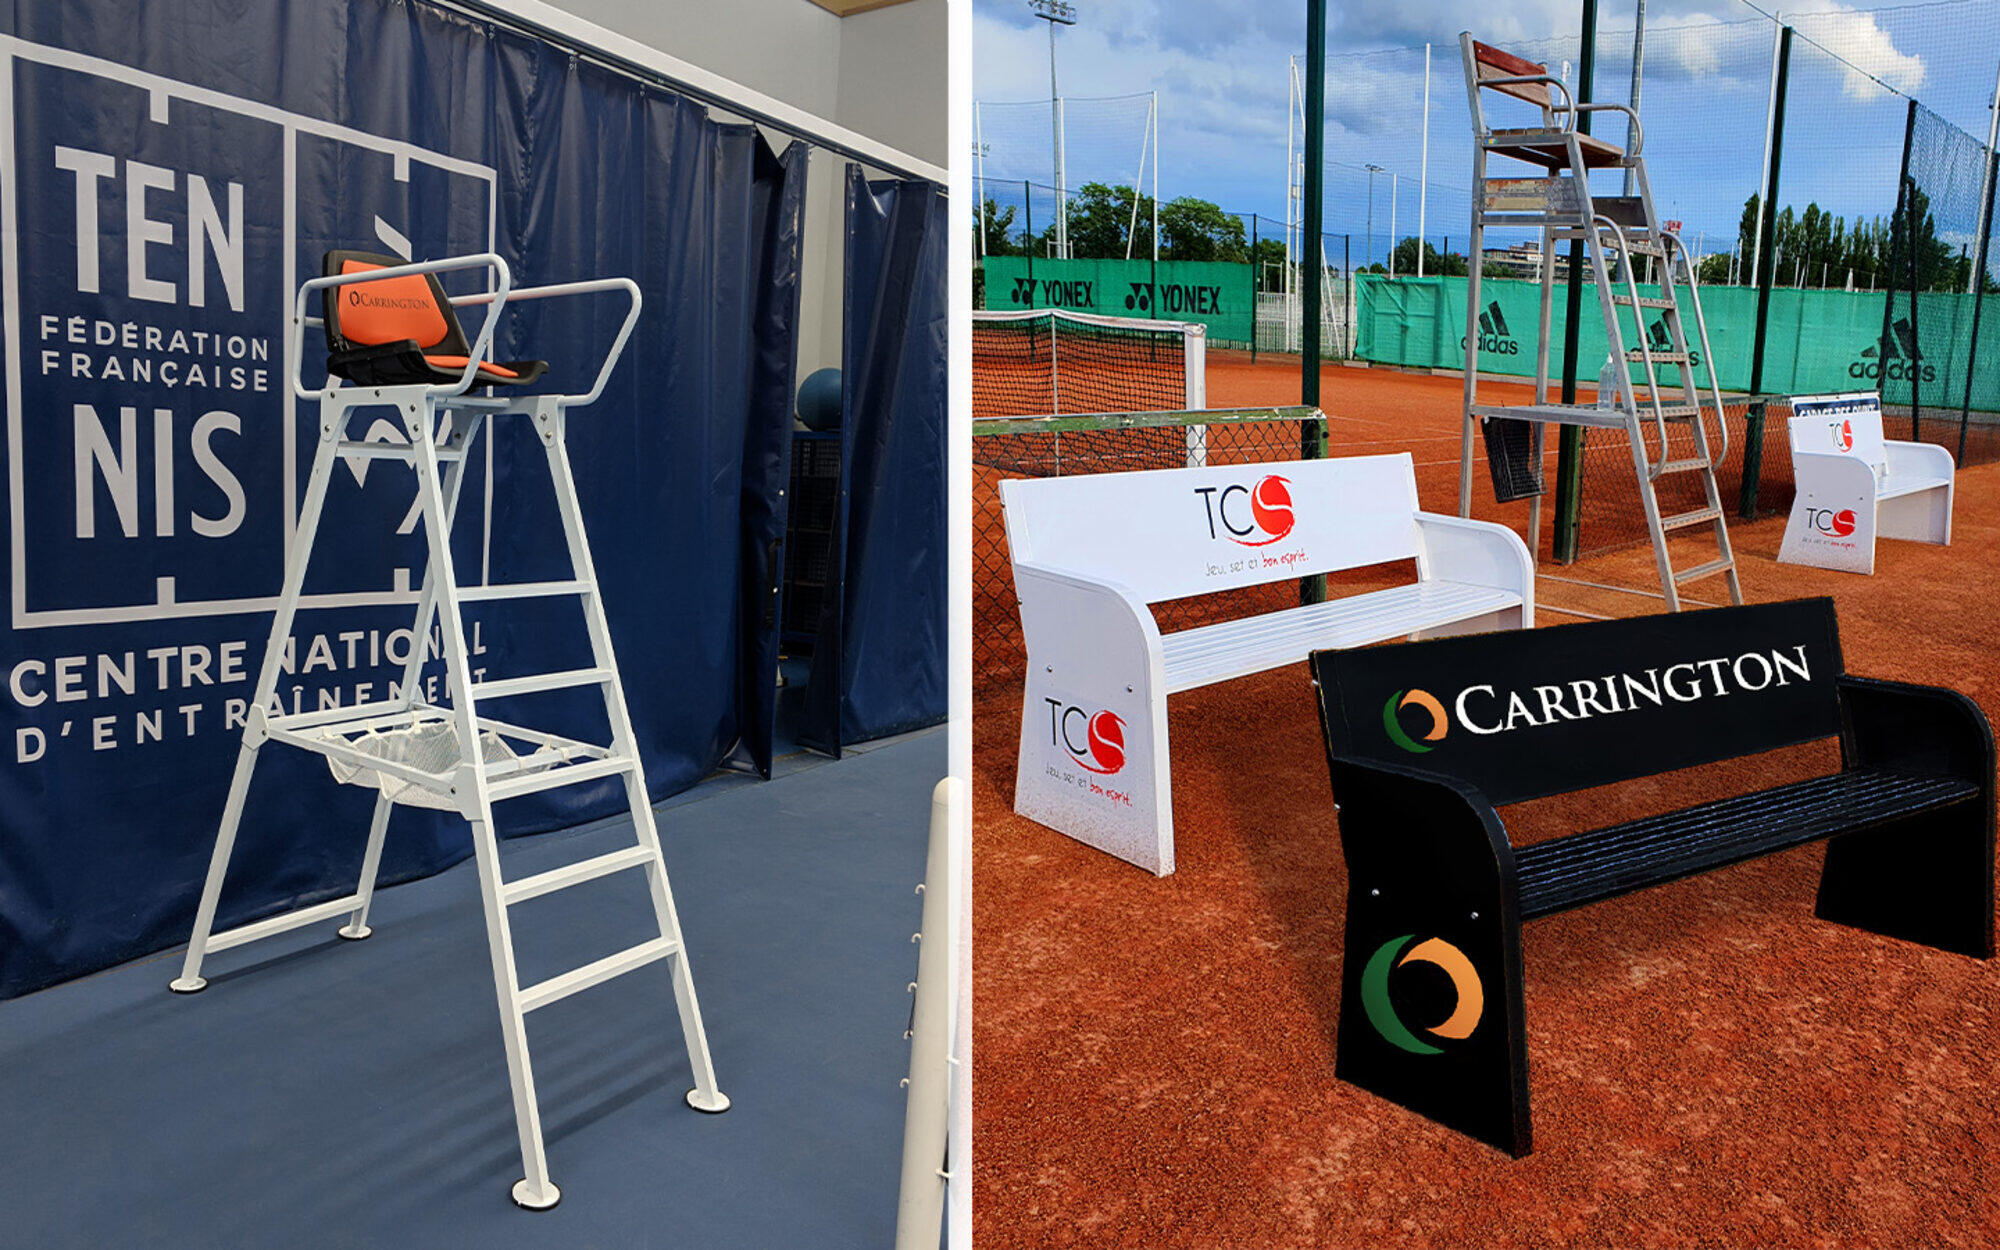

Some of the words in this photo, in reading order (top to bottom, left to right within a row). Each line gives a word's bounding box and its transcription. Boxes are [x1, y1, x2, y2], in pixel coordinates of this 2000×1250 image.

[55, 145, 244, 312] TEN
[1041, 279, 1094, 308] YONEX
[1159, 283, 1222, 315] YONEX
[41, 314, 268, 362] FÉDÉRATION
[41, 350, 268, 392] FRANÇAISE
[1848, 358, 1937, 383] addas
[73, 404, 246, 539] NIS
[1261, 550, 1279, 568] bon
[9, 640, 248, 708] CENTRE
[267, 621, 487, 675] NATIONL
[1454, 645, 1812, 735] CARRINGTON
